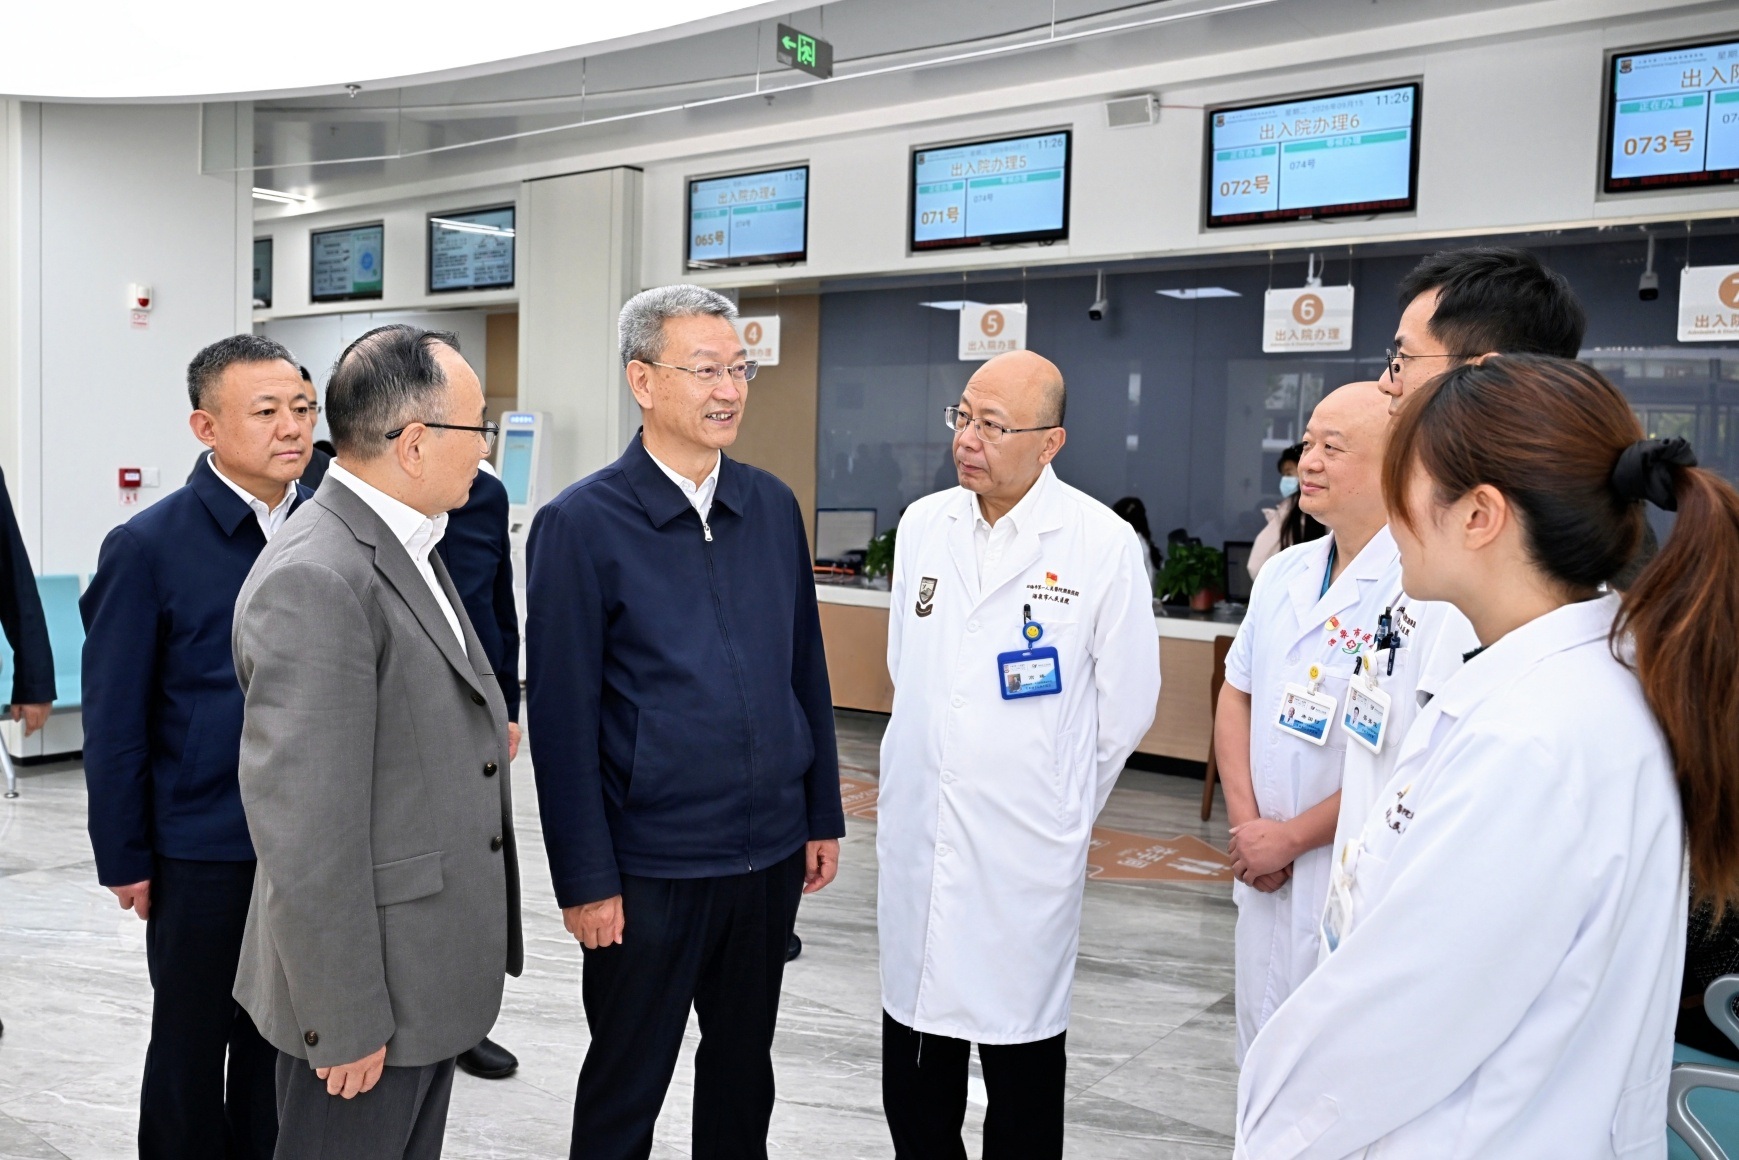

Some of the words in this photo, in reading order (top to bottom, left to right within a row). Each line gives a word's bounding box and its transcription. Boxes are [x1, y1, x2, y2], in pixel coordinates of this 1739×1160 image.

[1376, 91, 1409, 106] 11:26
[1722, 113, 1739, 124] 07
[1259, 114, 1360, 141] 出入院办理6
[1037, 137, 1064, 150] 11:26
[1624, 129, 1694, 156] 073号
[951, 155, 1027, 177] 出入院办理5
[1289, 159, 1315, 170] 074号
[1220, 175, 1270, 196] 072号
[718, 186, 777, 204] 出入院办理4
[921, 206, 959, 225] 071号
[695, 230, 725, 247] 065号
[1300, 299, 1315, 320] 6
[987, 314, 998, 333] 5
[748, 326, 758, 342] 4
[1275, 328, 1340, 341] 出入院办理
[968, 340, 1017, 351] 出入院办理
